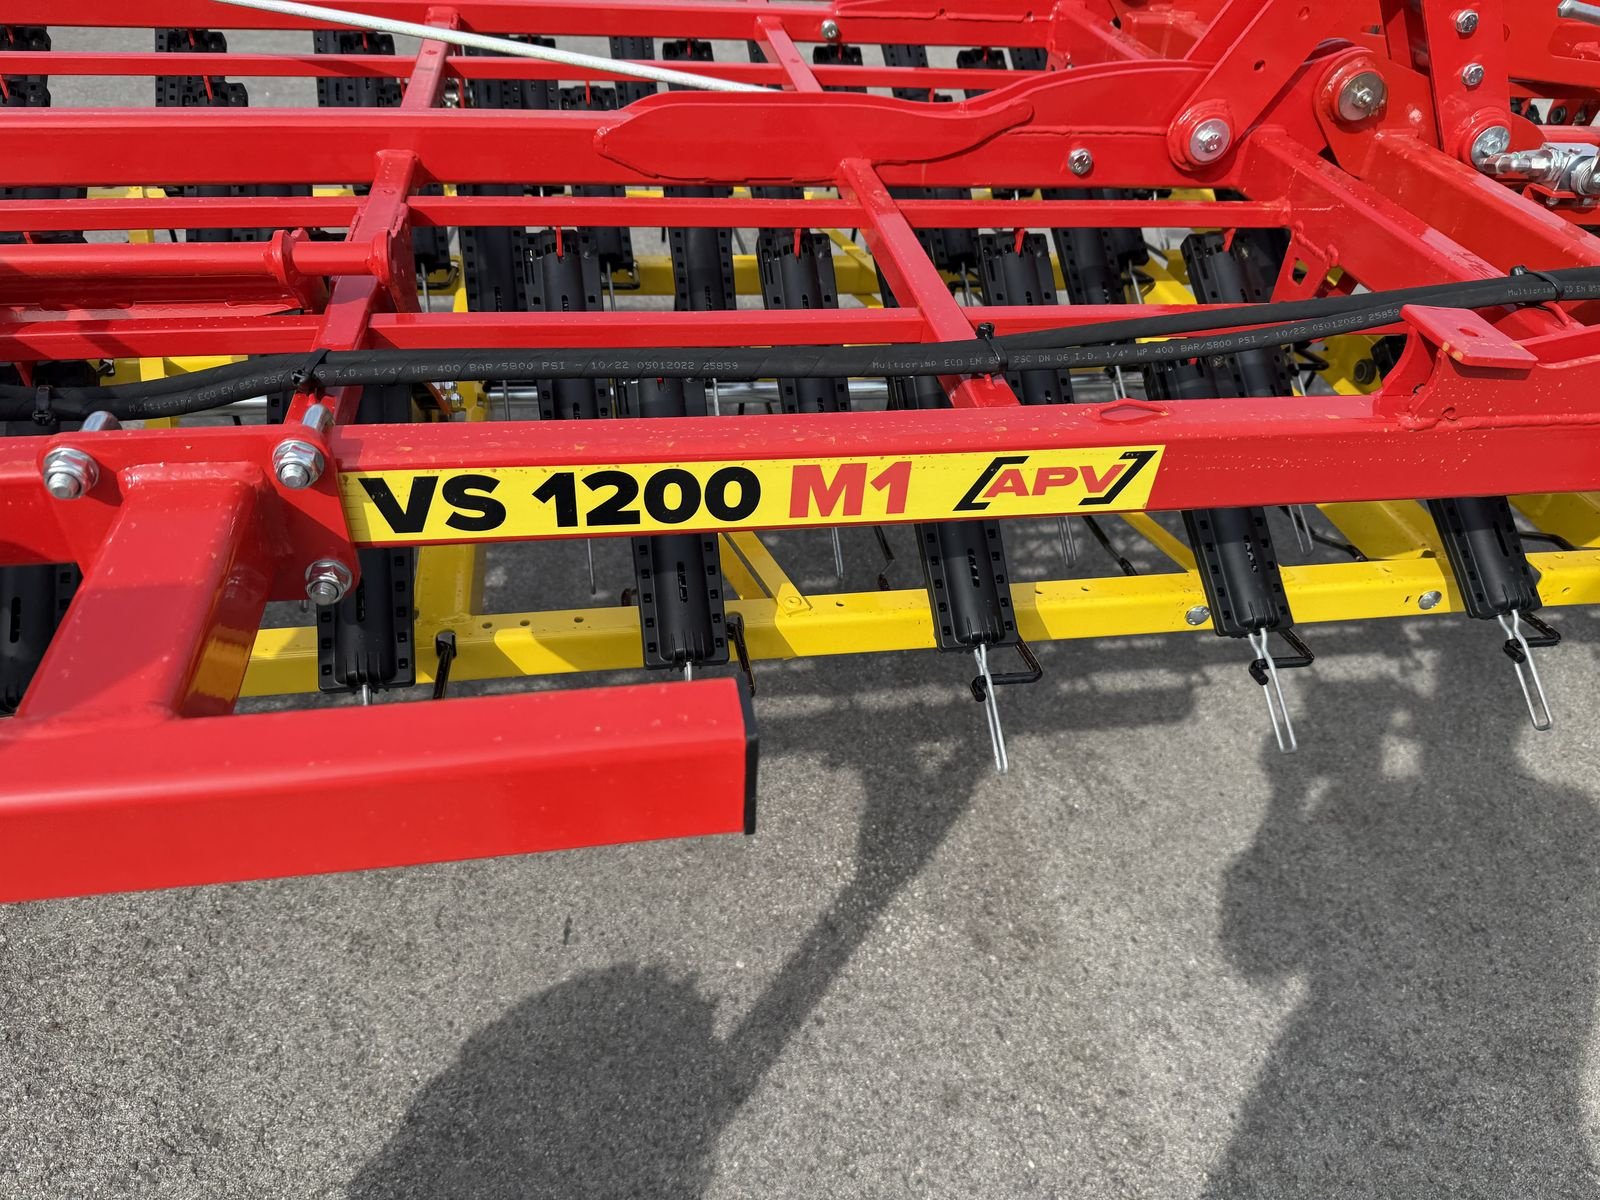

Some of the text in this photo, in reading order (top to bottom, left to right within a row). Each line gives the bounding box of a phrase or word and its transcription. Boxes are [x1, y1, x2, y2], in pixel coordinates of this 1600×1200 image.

[944, 358, 963, 368] ECO
[969, 357, 982, 366] EN
[1013, 355, 1032, 364] 2SC
[1038, 354, 1051, 363] DN
[1056, 353, 1068, 362] 06
[1075, 352, 1098, 361] I.D.
[1136, 347, 1148, 357] WP
[1155, 346, 1174, 354] 400
[1180, 339, 1232, 352] BAR/5800
[1238, 335, 1257, 345] PSI
[1275, 326, 1306, 338] 10/22
[1312, 315, 1364, 331] 05012022
[1368, 308, 1400, 321] 25859
[197, 391, 217, 402] ECO
[221, 385, 235, 396] EN
[239, 379, 258, 390] 857
[263, 375, 285, 385] 2SC
[411, 365, 429, 375] WP
[437, 363, 462, 373] 400
[469, 362, 534, 373] BAR/5800
[542, 361, 565, 370] PSI
[591, 360, 630, 370] 10/22
[637, 361, 695, 371] 05012022
[703, 361, 739, 370] 25859
[358, 461, 912, 533] VS 1200 M1
